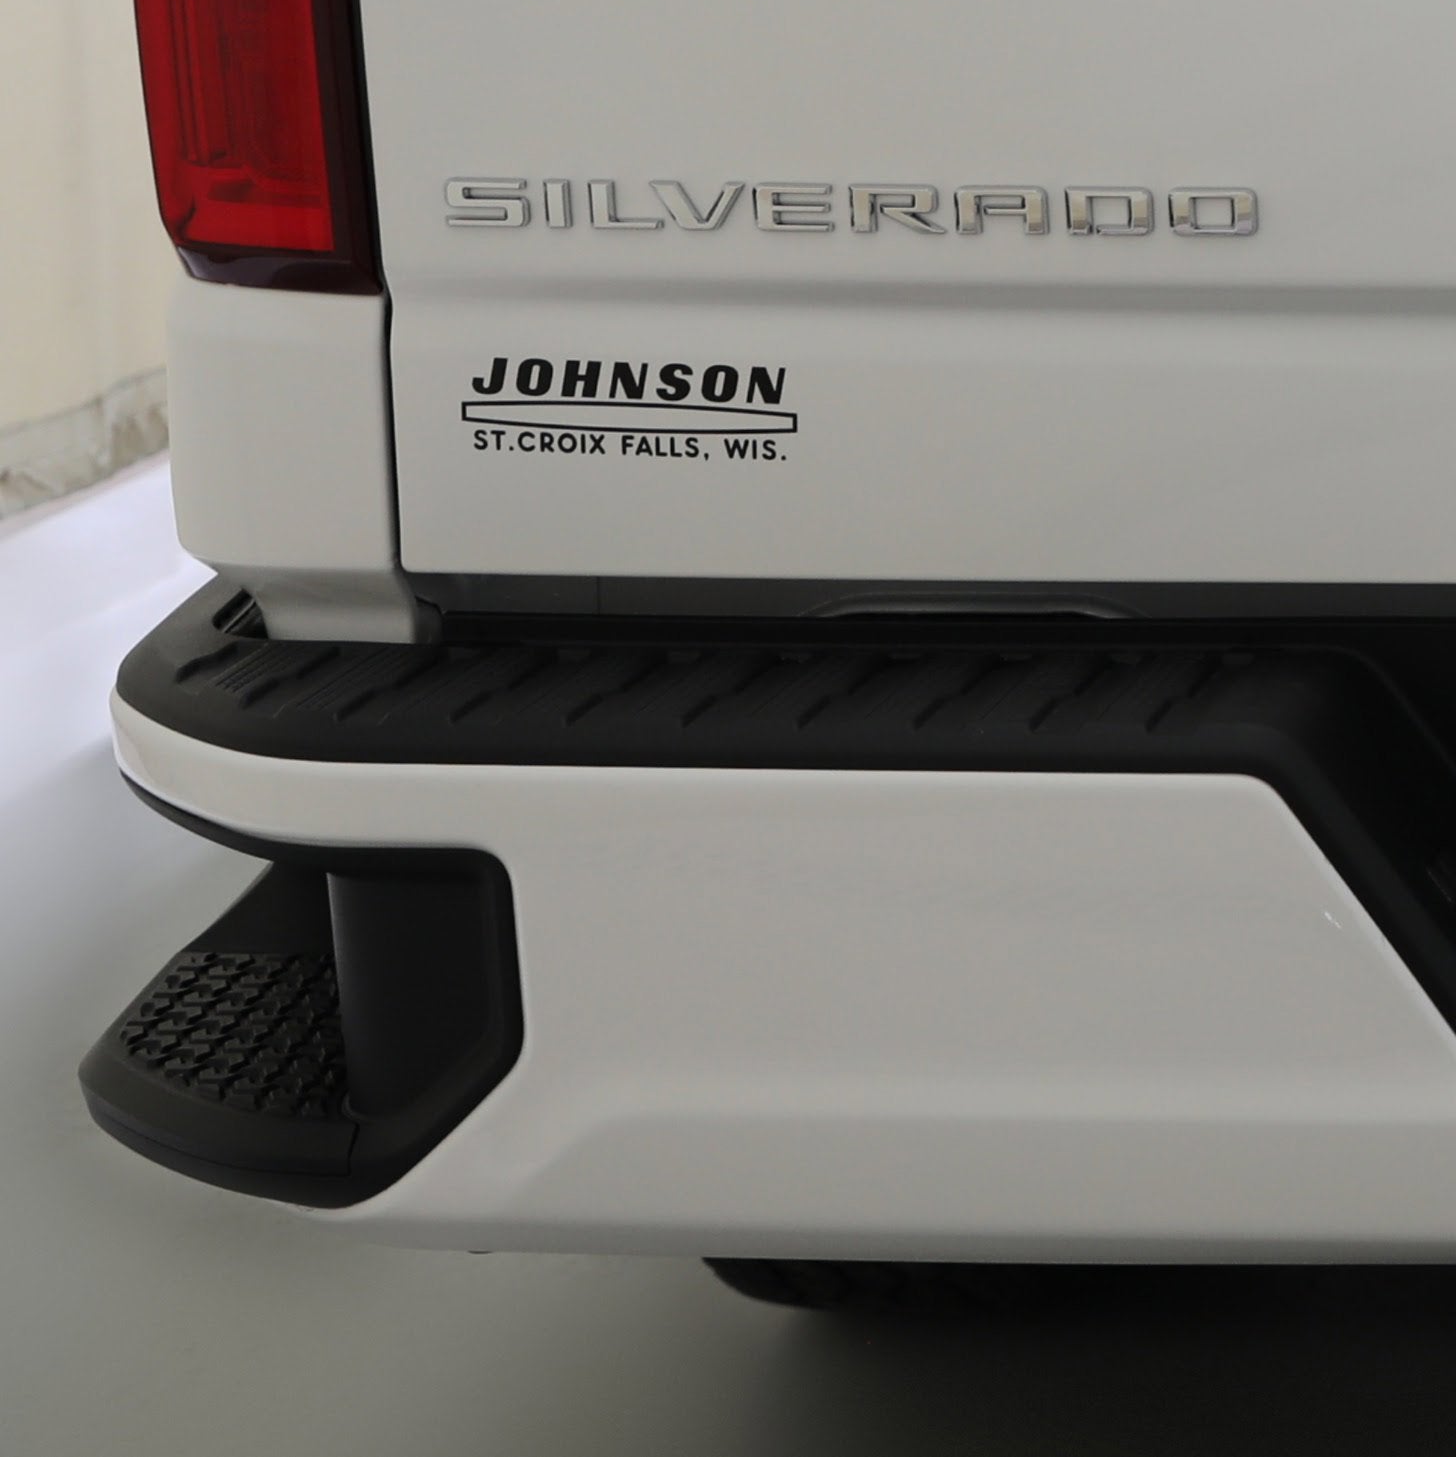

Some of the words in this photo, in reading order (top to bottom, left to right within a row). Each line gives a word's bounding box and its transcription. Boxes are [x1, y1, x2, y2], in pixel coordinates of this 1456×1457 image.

[443, 176, 1260, 237] SILVERADO
[471, 357, 787, 405] JOHNSON
[620, 434, 710, 461] FALLS,
[723, 437, 788, 461] WIS.
